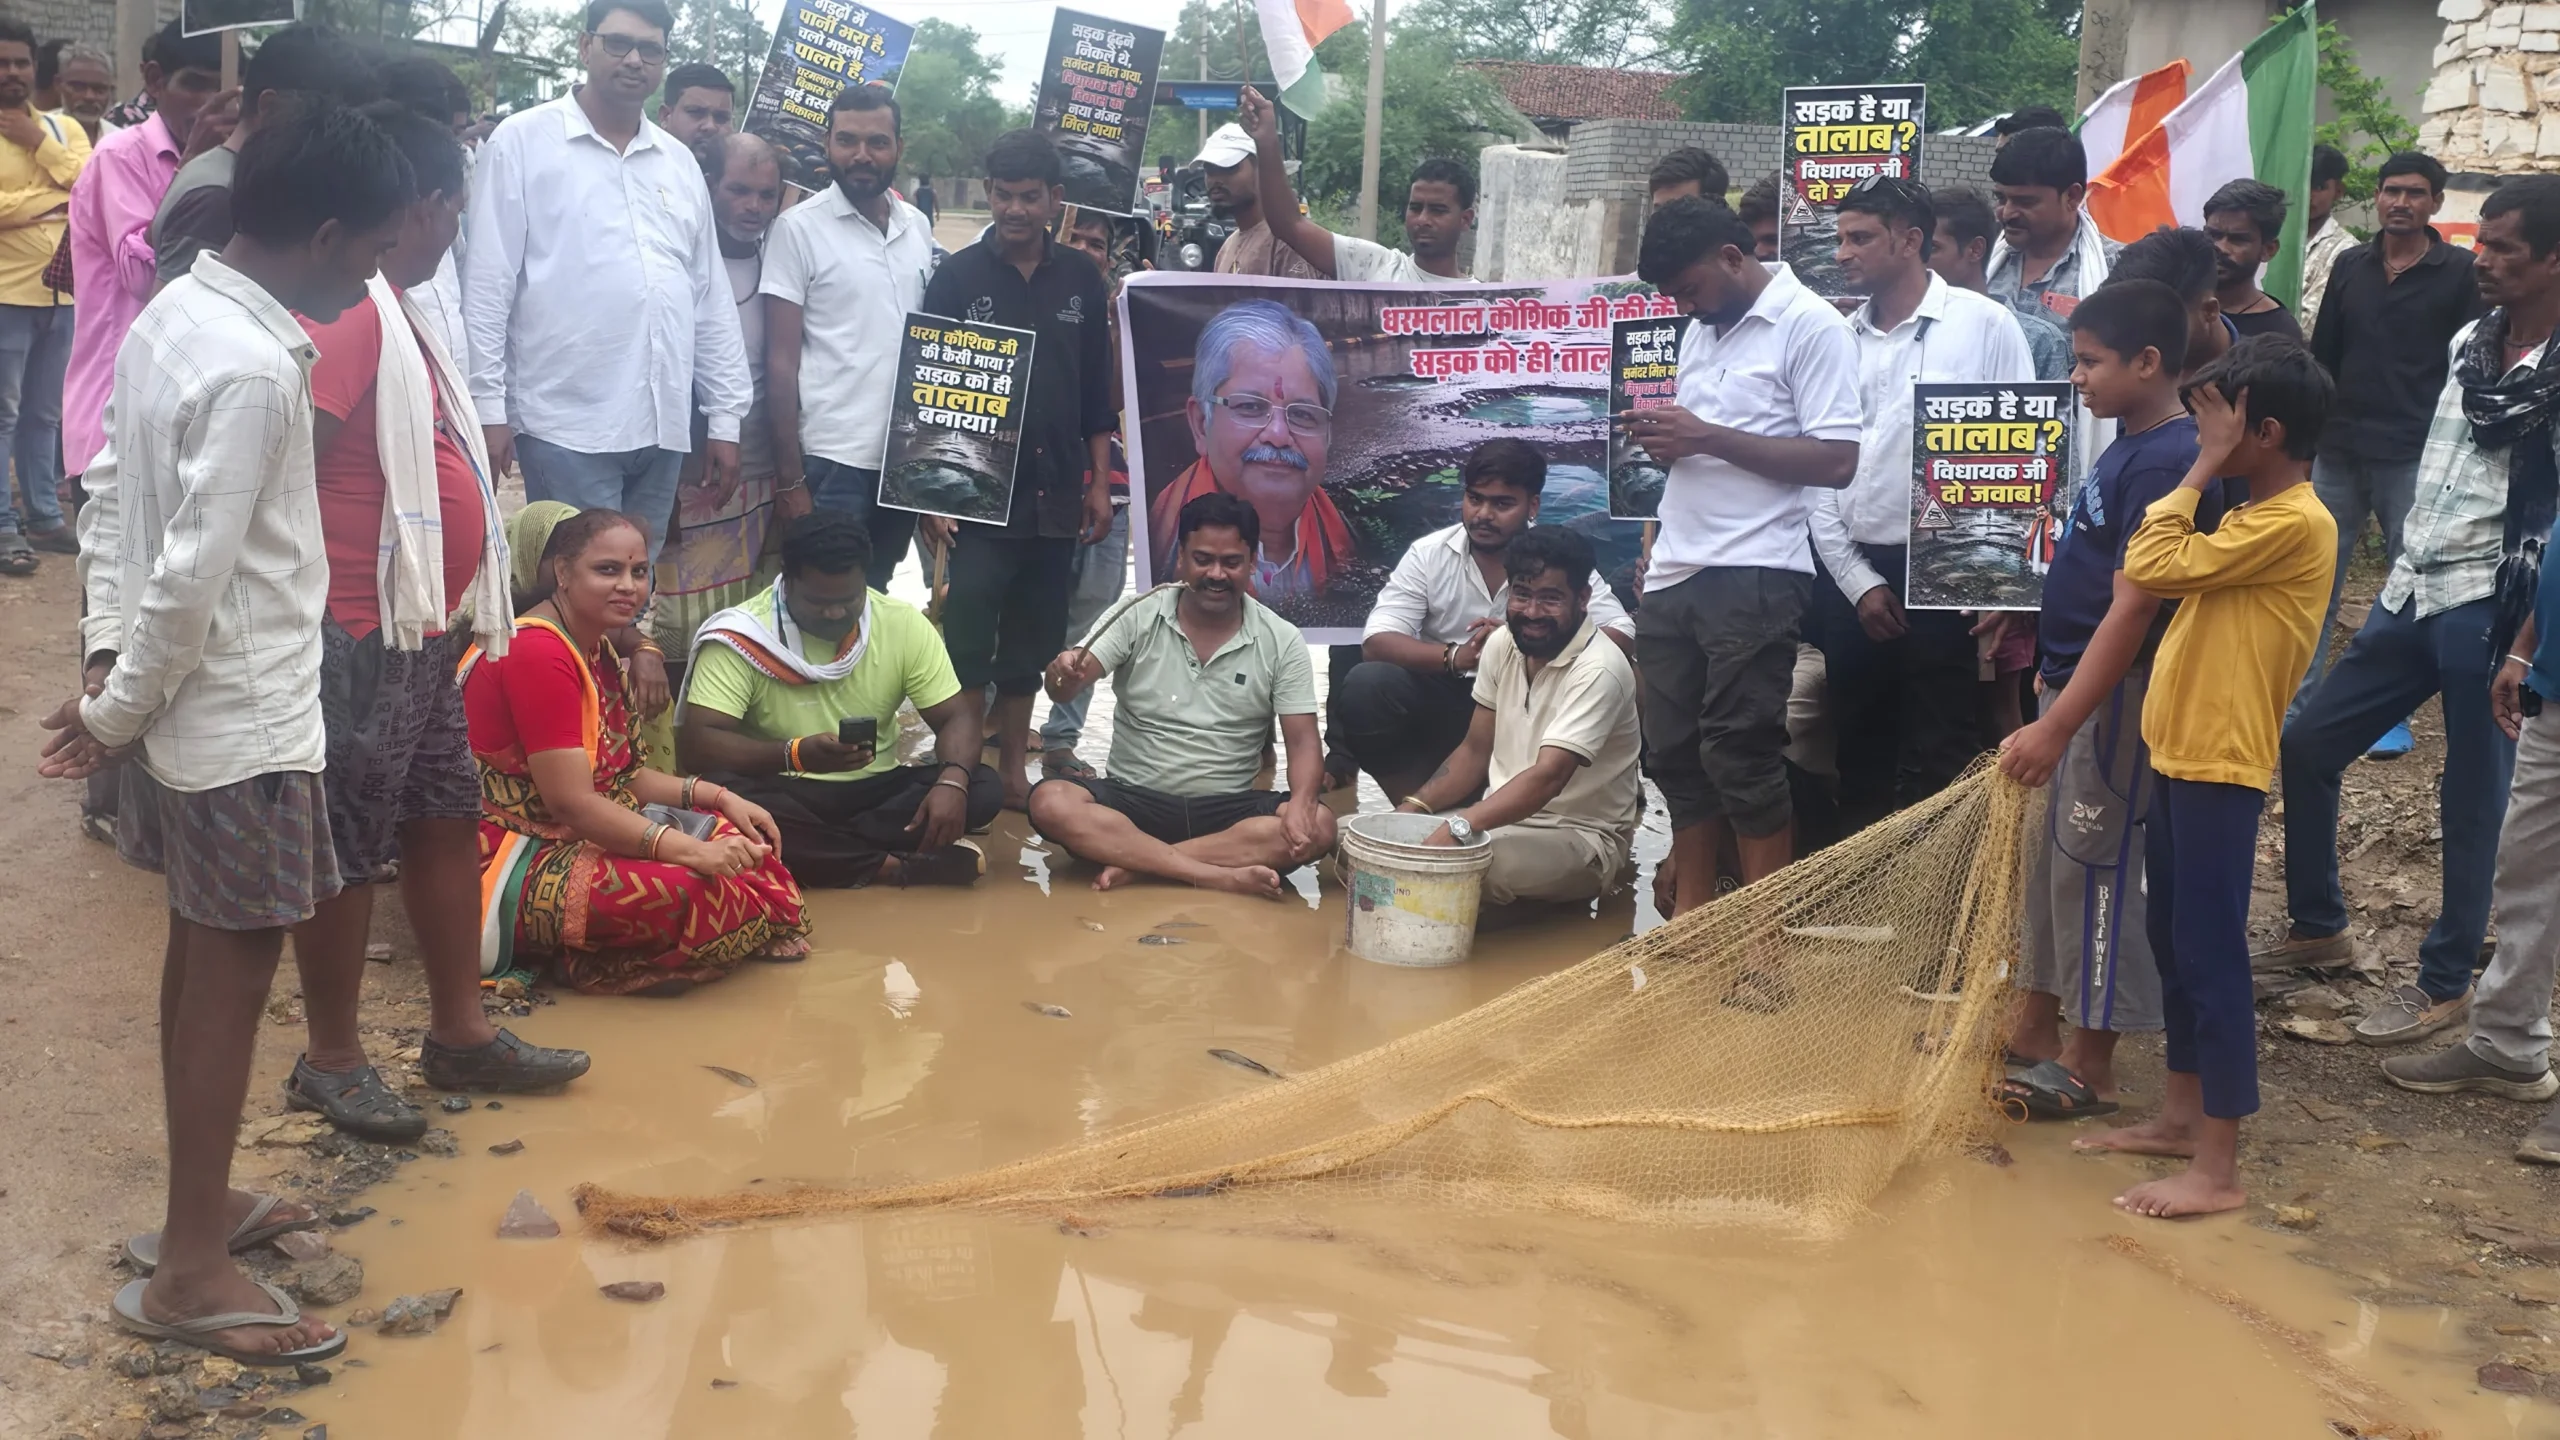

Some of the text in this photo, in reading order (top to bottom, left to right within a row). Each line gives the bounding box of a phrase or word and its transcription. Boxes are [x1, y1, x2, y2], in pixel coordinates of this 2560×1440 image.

[852, 10, 868, 27] में
[798, 27, 864, 61] चलो मछली
[838, 24, 870, 47] भरा
[1072, 23, 1106, 42] सड़क
[795, 41, 846, 73] पालते
[1075, 40, 1117, 63] निकले
[1062, 56, 1096, 73] समंदर
[1096, 61, 1119, 78] मिल
[784, 86, 804, 104] नई
[1109, 97, 1126, 111] का
[782, 99, 826, 124] निकालते
[1068, 103, 1122, 124] नया मंजर
[1795, 94, 1911, 126] सड़क है या
[1061, 114, 1122, 140] मिल गया!
[1801, 158, 1902, 180] विधायक जी
[1807, 179, 1830, 202] दो
[1382, 306, 1485, 335] धरमलाल
[1489, 297, 1572, 332] कौशिक
[1576, 295, 1610, 329] जी
[909, 325, 1019, 356] धरम कौशिक जी
[1626, 330, 1651, 347] सड़क
[921, 344, 941, 361] की
[942, 345, 972, 366] कैसी
[1411, 342, 1611, 380] सड़क को ही ताल
[1631, 346, 1662, 364] निकले
[915, 364, 1013, 395] सड़क को ही
[1623, 364, 1647, 379] समंदर
[1648, 363, 1666, 378] मिल
[1660, 378, 1673, 394] जी
[912, 382, 1011, 418] तालाब
[1925, 390, 2058, 424] सड़क है या
[918, 406, 998, 434] बनाया!
[1932, 458, 2049, 481] विधायक जी
[1940, 480, 1967, 505] दो
